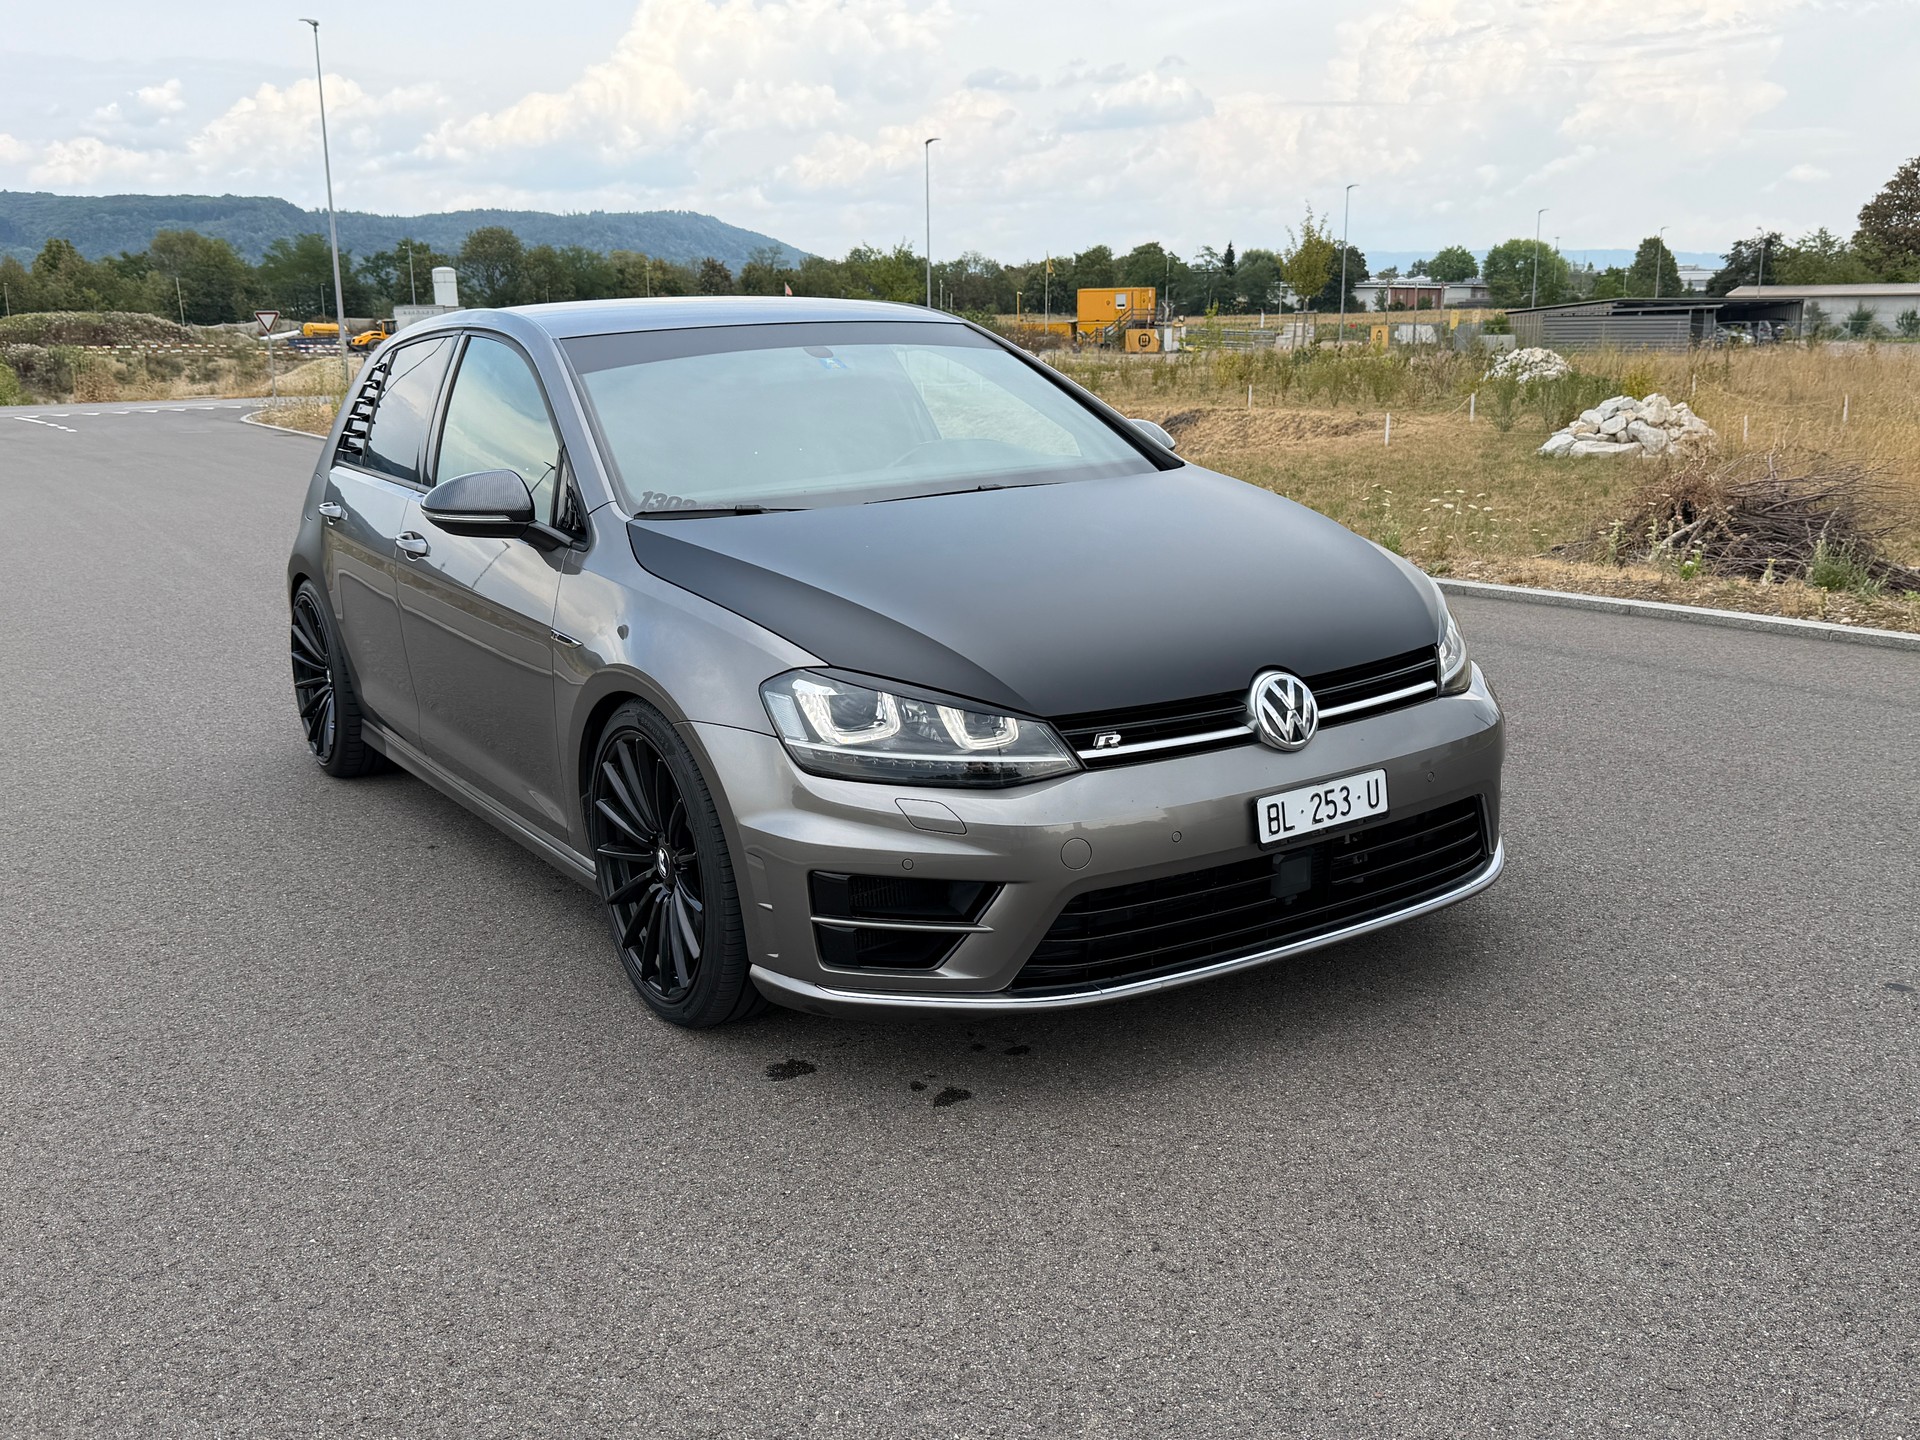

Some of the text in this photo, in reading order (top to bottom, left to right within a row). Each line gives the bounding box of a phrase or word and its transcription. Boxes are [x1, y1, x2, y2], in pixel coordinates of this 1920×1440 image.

[1258, 671, 1316, 745] VW
[1093, 731, 1121, 749] R
[1267, 778, 1380, 836] BL 253 U
